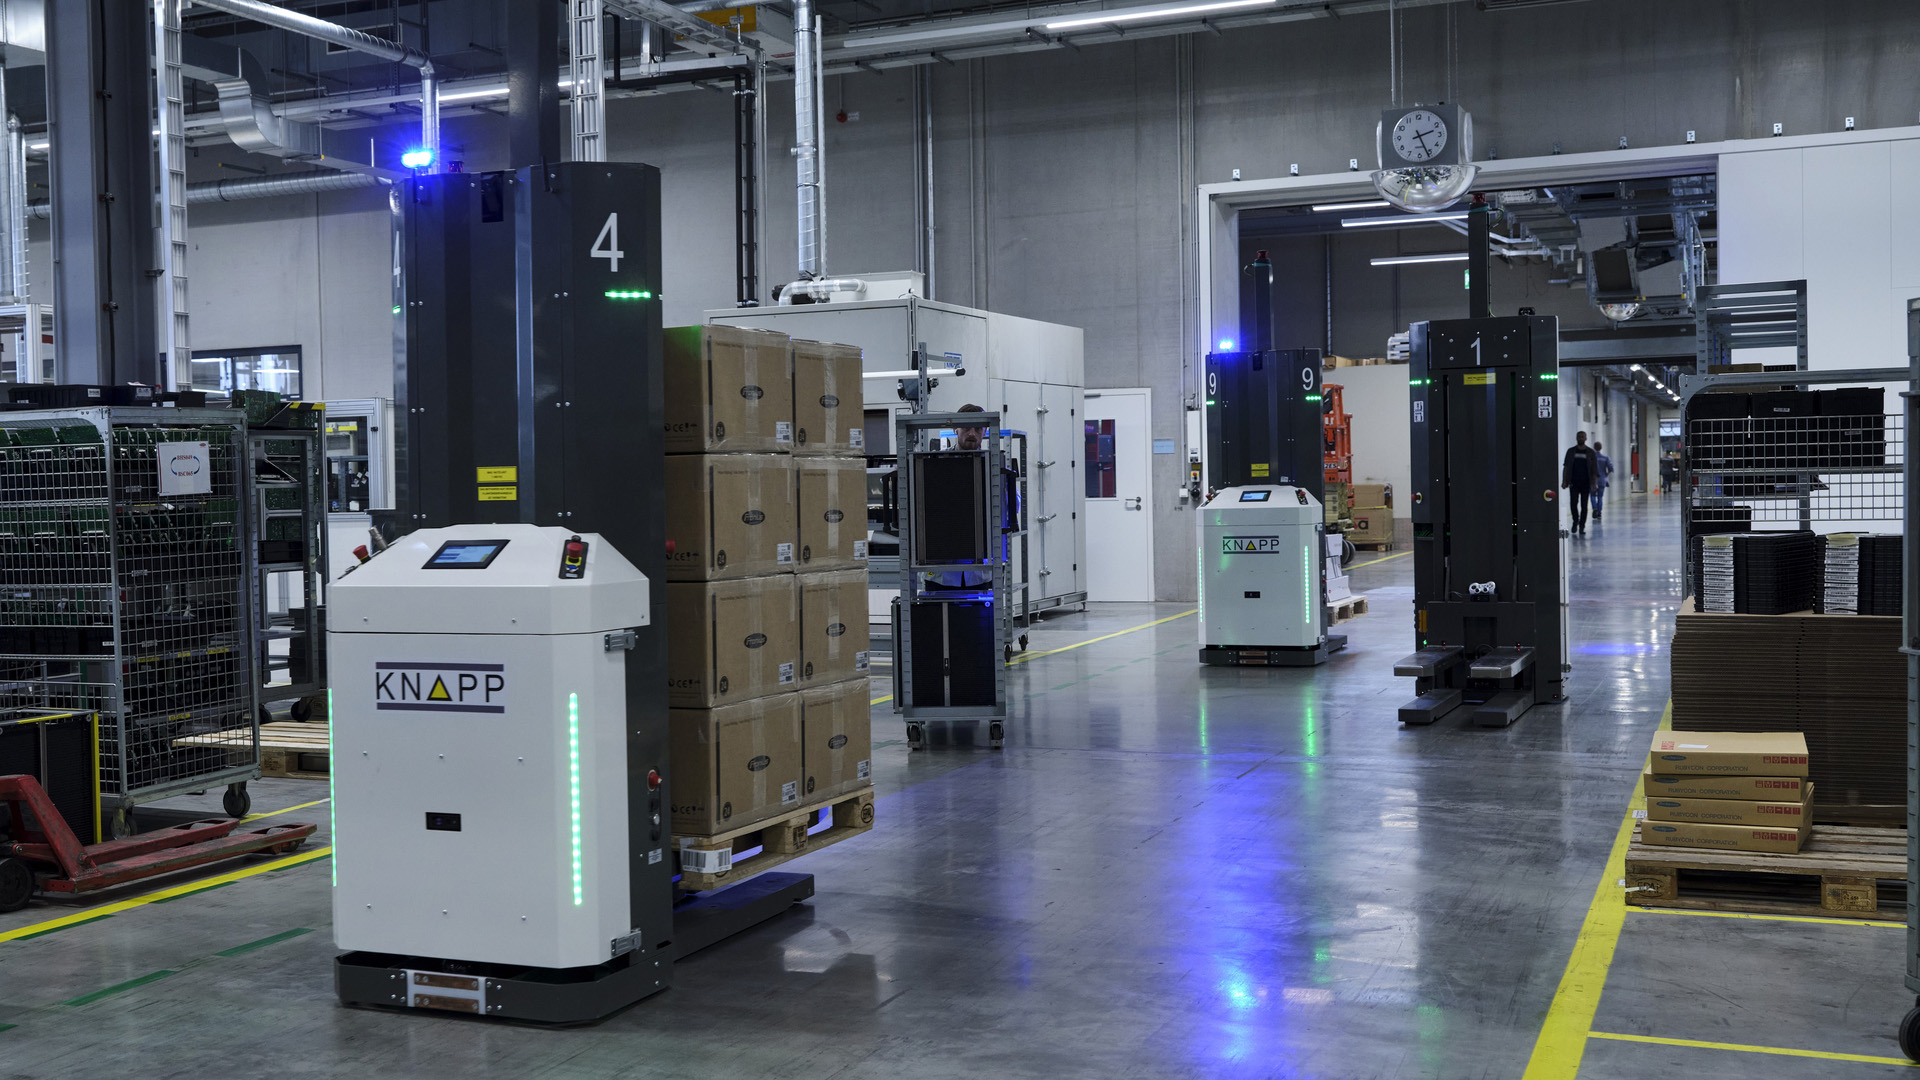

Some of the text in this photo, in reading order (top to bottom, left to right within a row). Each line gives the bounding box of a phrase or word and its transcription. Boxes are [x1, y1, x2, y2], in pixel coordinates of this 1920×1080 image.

[590, 212, 624, 272] 4
[393, 230, 401, 288] 4
[1470, 337, 1480, 366] 1
[1209, 372, 1216, 395] 9
[1302, 368, 1314, 390] 9
[1223, 539, 1280, 550] KNAPP
[376, 672, 504, 702] KNAPP
